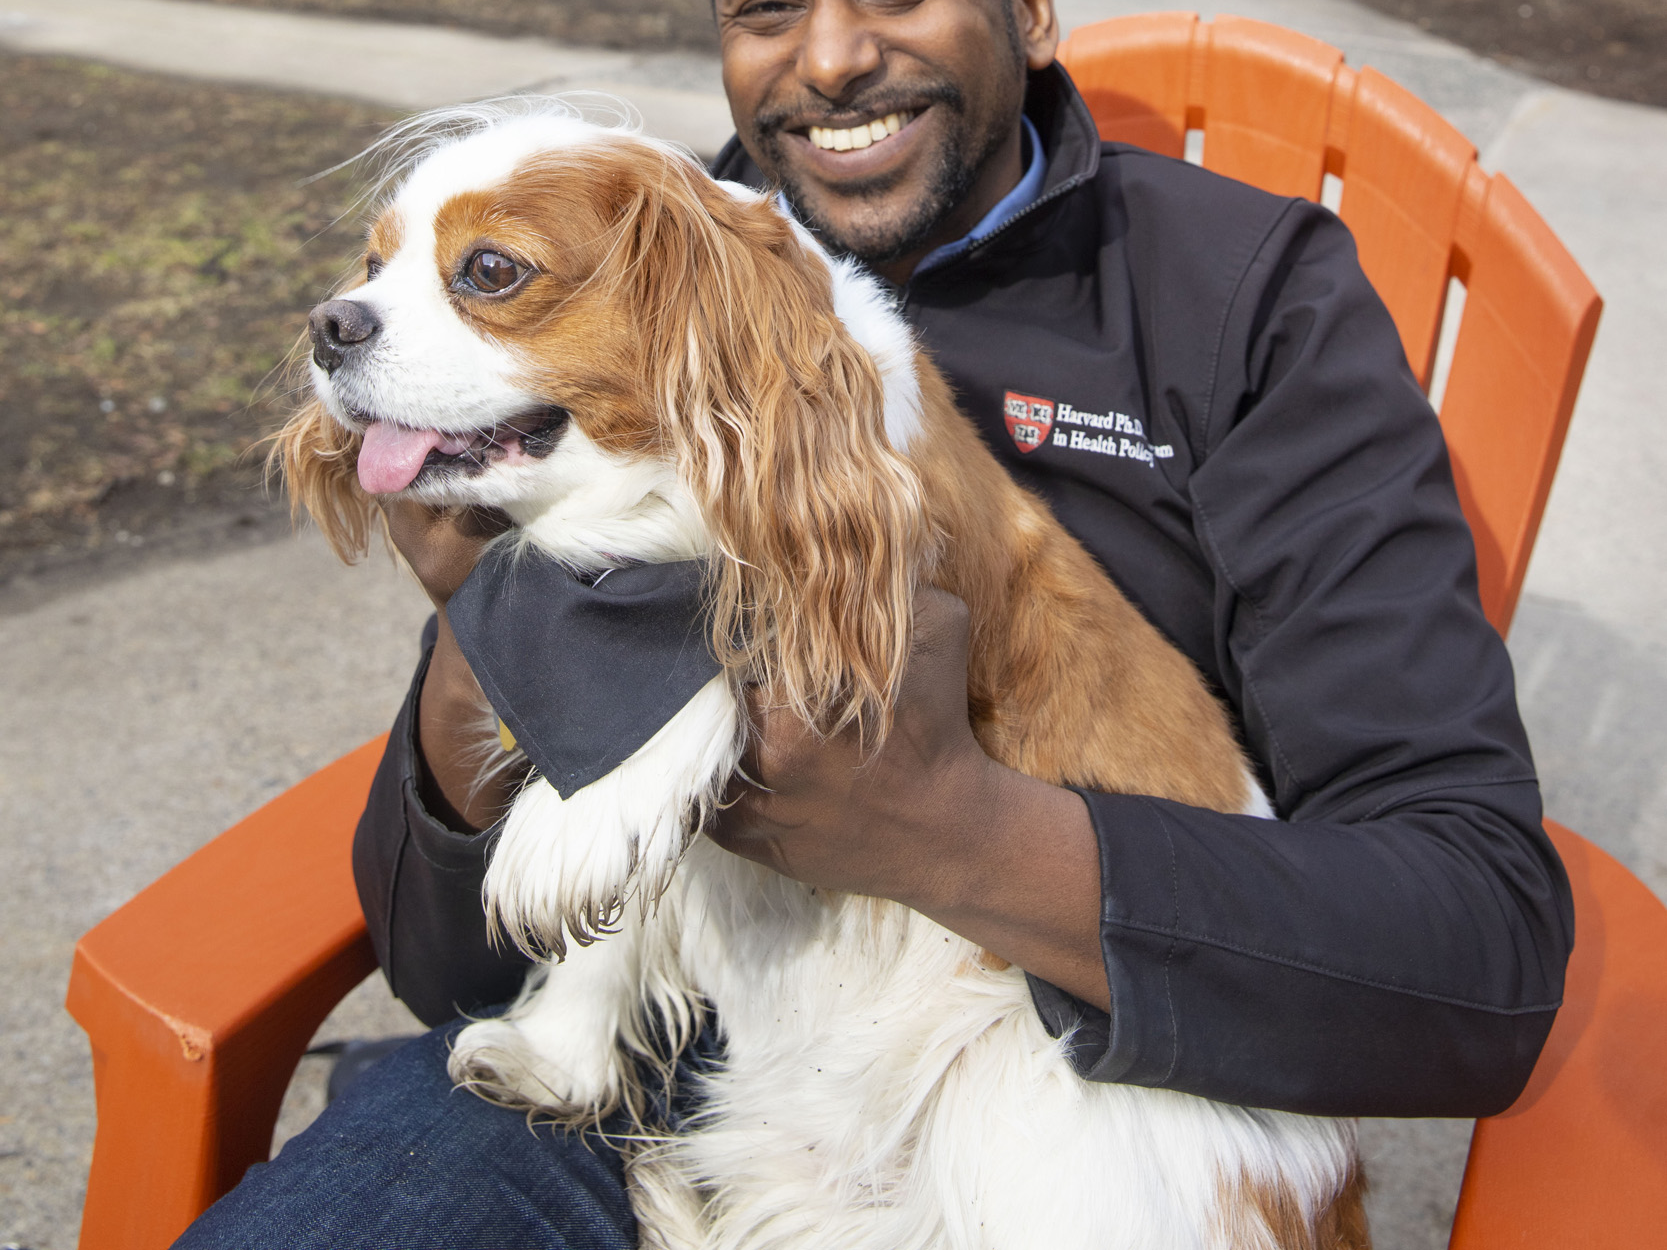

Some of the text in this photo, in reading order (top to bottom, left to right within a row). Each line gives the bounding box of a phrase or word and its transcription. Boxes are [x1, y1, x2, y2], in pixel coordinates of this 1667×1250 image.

[1056, 403, 1114, 429] Harvard
[1052, 427, 1067, 447] in
[1069, 429, 1117, 456] Health
